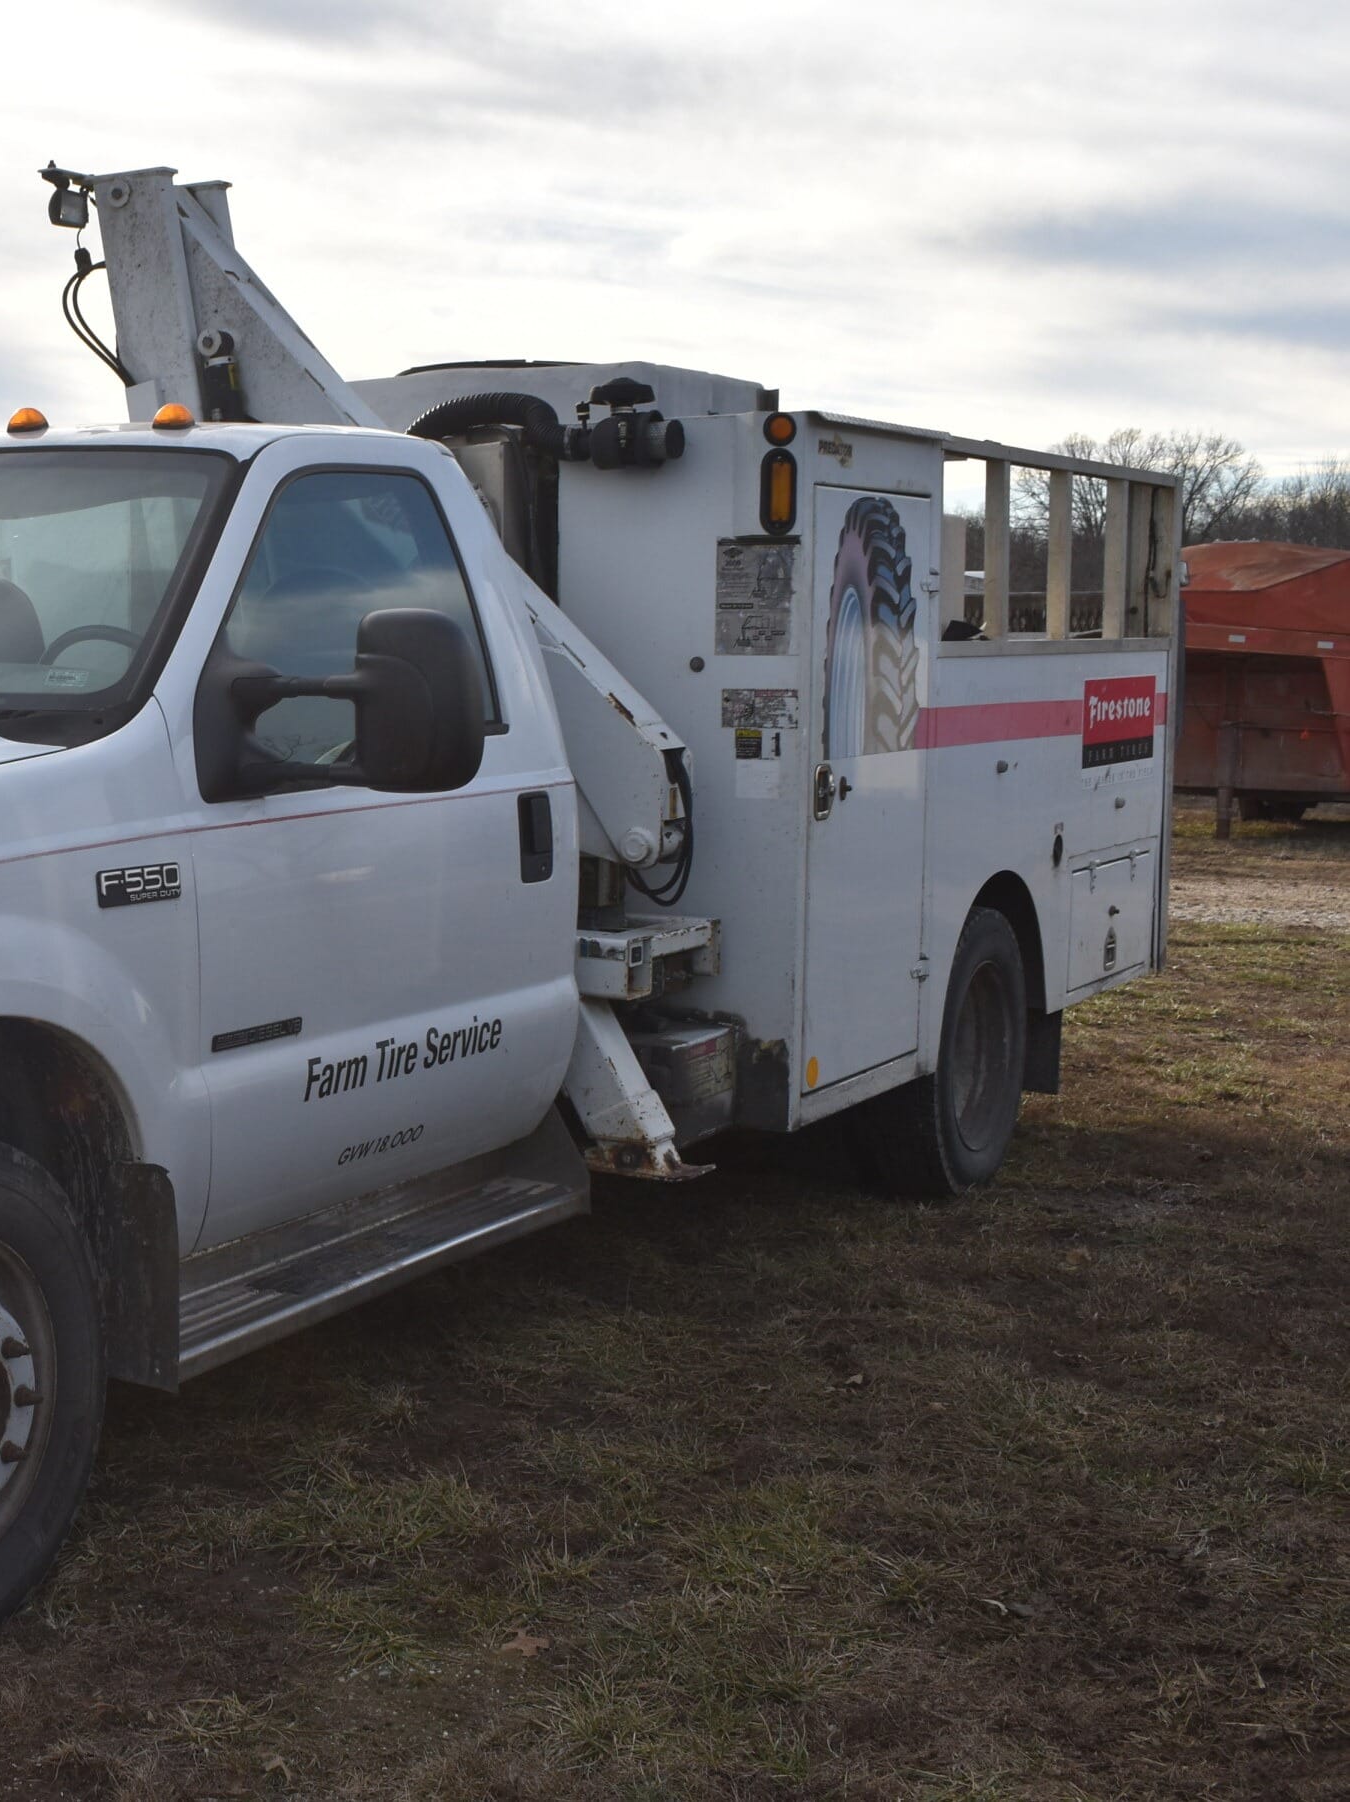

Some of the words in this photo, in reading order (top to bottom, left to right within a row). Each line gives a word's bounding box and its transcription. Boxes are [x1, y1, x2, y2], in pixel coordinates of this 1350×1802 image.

[1088, 696, 1151, 729] Firestone
[130, 891, 158, 902] SUPER
[159, 888, 181, 897] DUTY
[304, 1056, 367, 1102] Farm
[375, 1038, 418, 1082] Tire
[423, 1015, 502, 1069] Service
[338, 1138, 374, 1165] GVW
